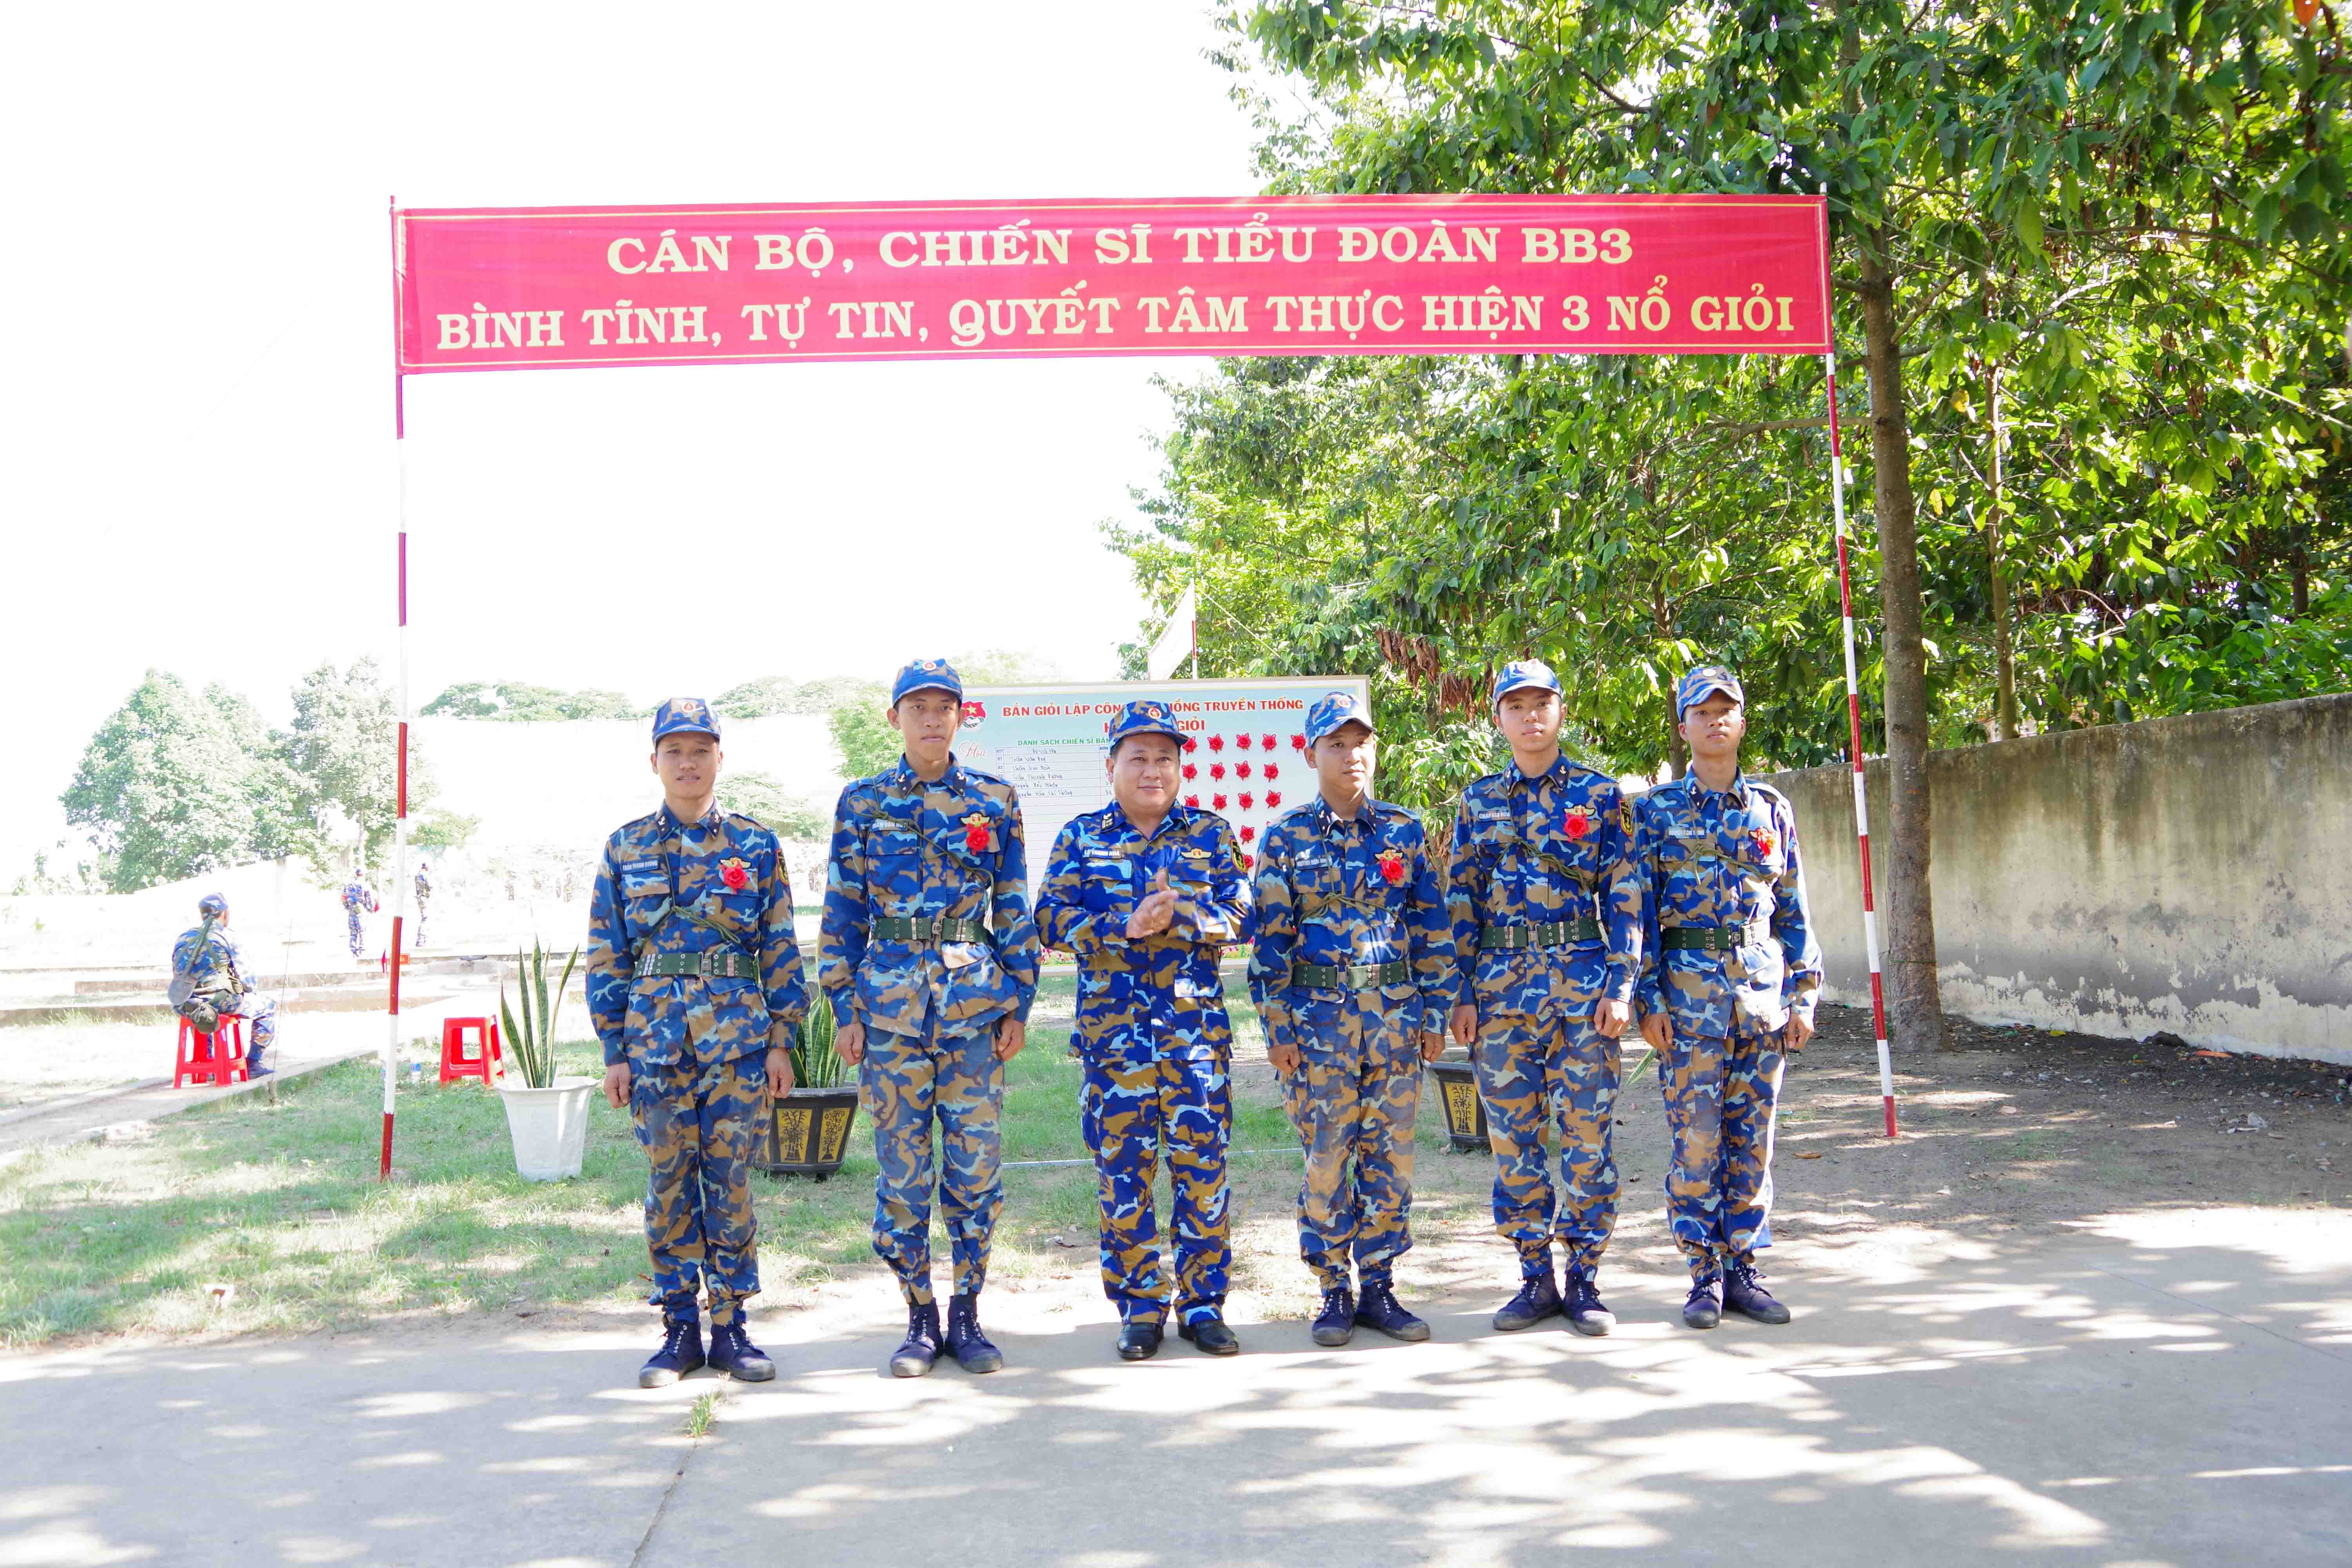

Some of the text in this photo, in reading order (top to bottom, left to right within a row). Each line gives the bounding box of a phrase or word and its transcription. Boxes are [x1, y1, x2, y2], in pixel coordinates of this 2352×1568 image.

[607, 212, 1633, 278] CÁN BỘ, CHIẾN SĨ TIỂU ĐOÀN BB3
[436, 275, 1794, 350] BÌNH TĨNH, TỰ TIN, QUYẾT TÂM THỰC HIỆN 3 NỔ GIỎI
[1003, 702, 1030, 717] BẮN
[1034, 702, 1060, 716] GIỎI
[1065, 702, 1091, 717] LẬP
[1094, 702, 1122, 714] CÔN
[1204, 696, 1256, 711] TRUYỀN
[1259, 696, 1304, 710] THỐNG
[1177, 715, 1205, 731] GIỎI
[1062, 737, 1084, 745] CHIẾN
